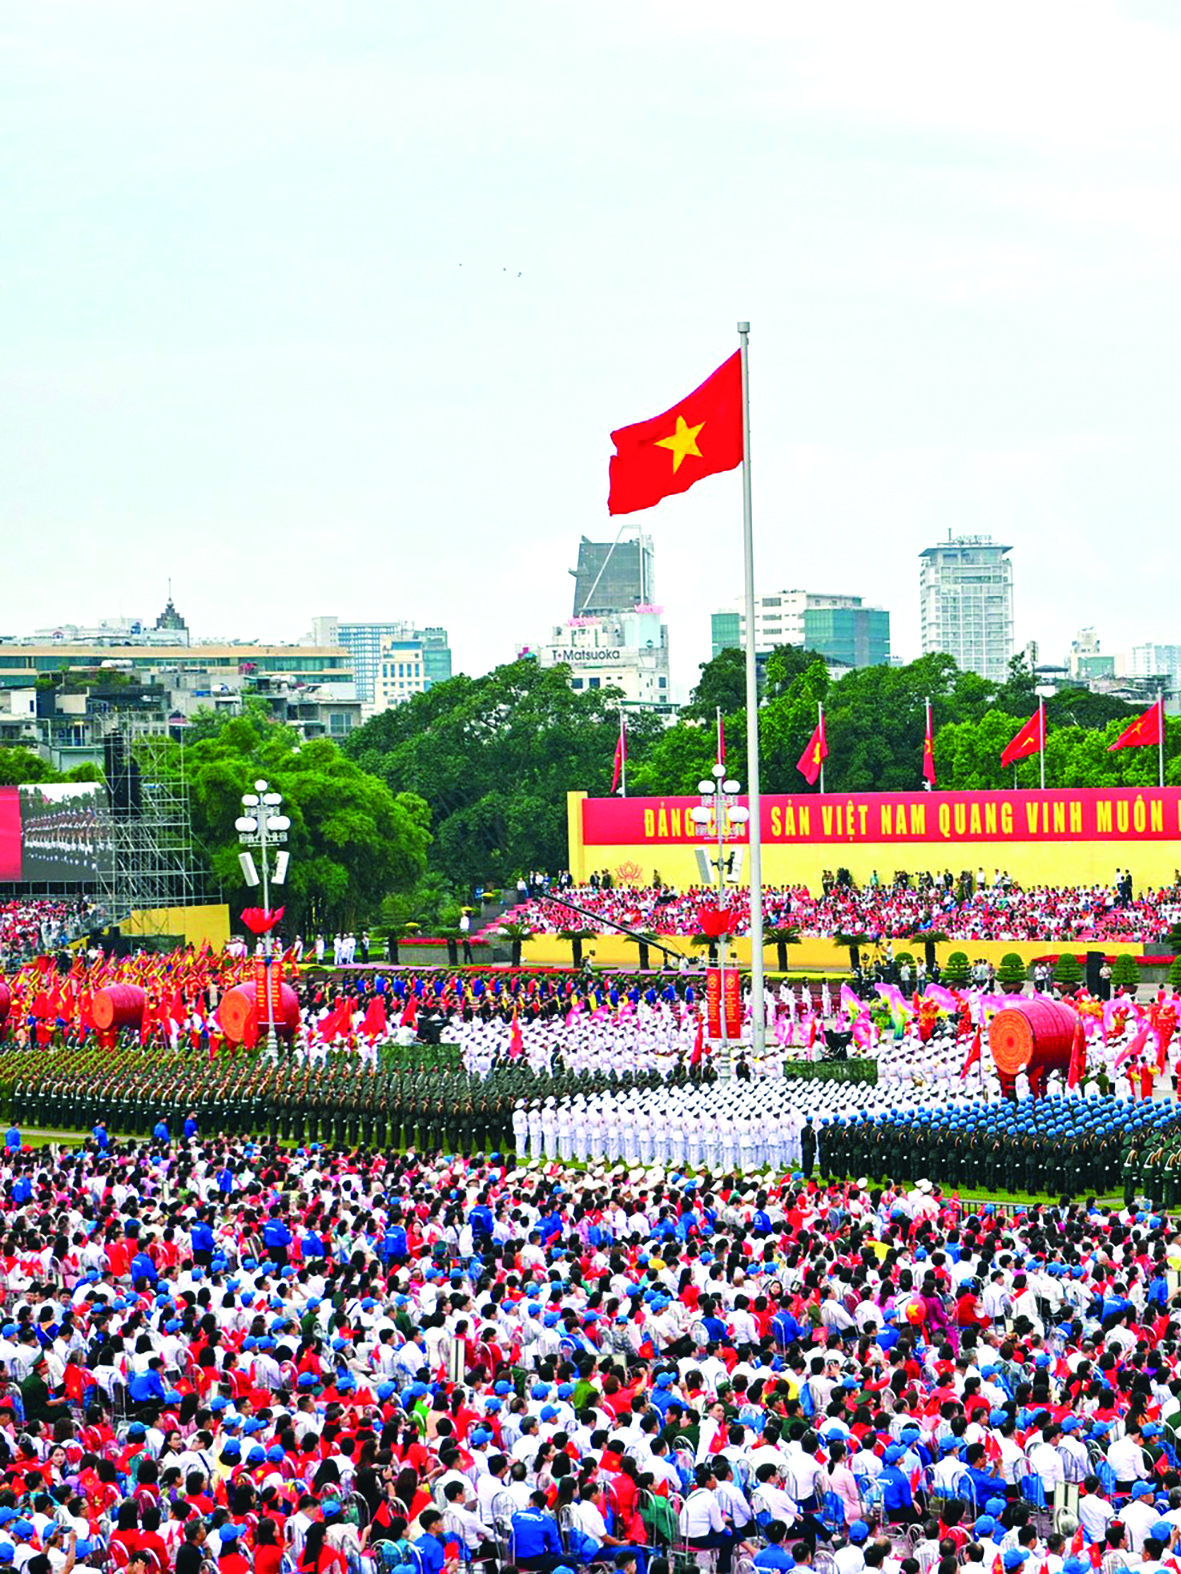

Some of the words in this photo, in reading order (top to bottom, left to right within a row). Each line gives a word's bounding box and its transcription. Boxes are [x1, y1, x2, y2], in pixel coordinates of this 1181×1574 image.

[644, 801, 696, 837] ĐẢNG
[771, 798, 810, 837] SẢN
[821, 799, 869, 841] VIỆT
[880, 804, 926, 835] NAM
[938, 802, 1013, 838] QUANG
[1026, 800, 1082, 834] VINH
[1096, 794, 1164, 833] MUÔN
